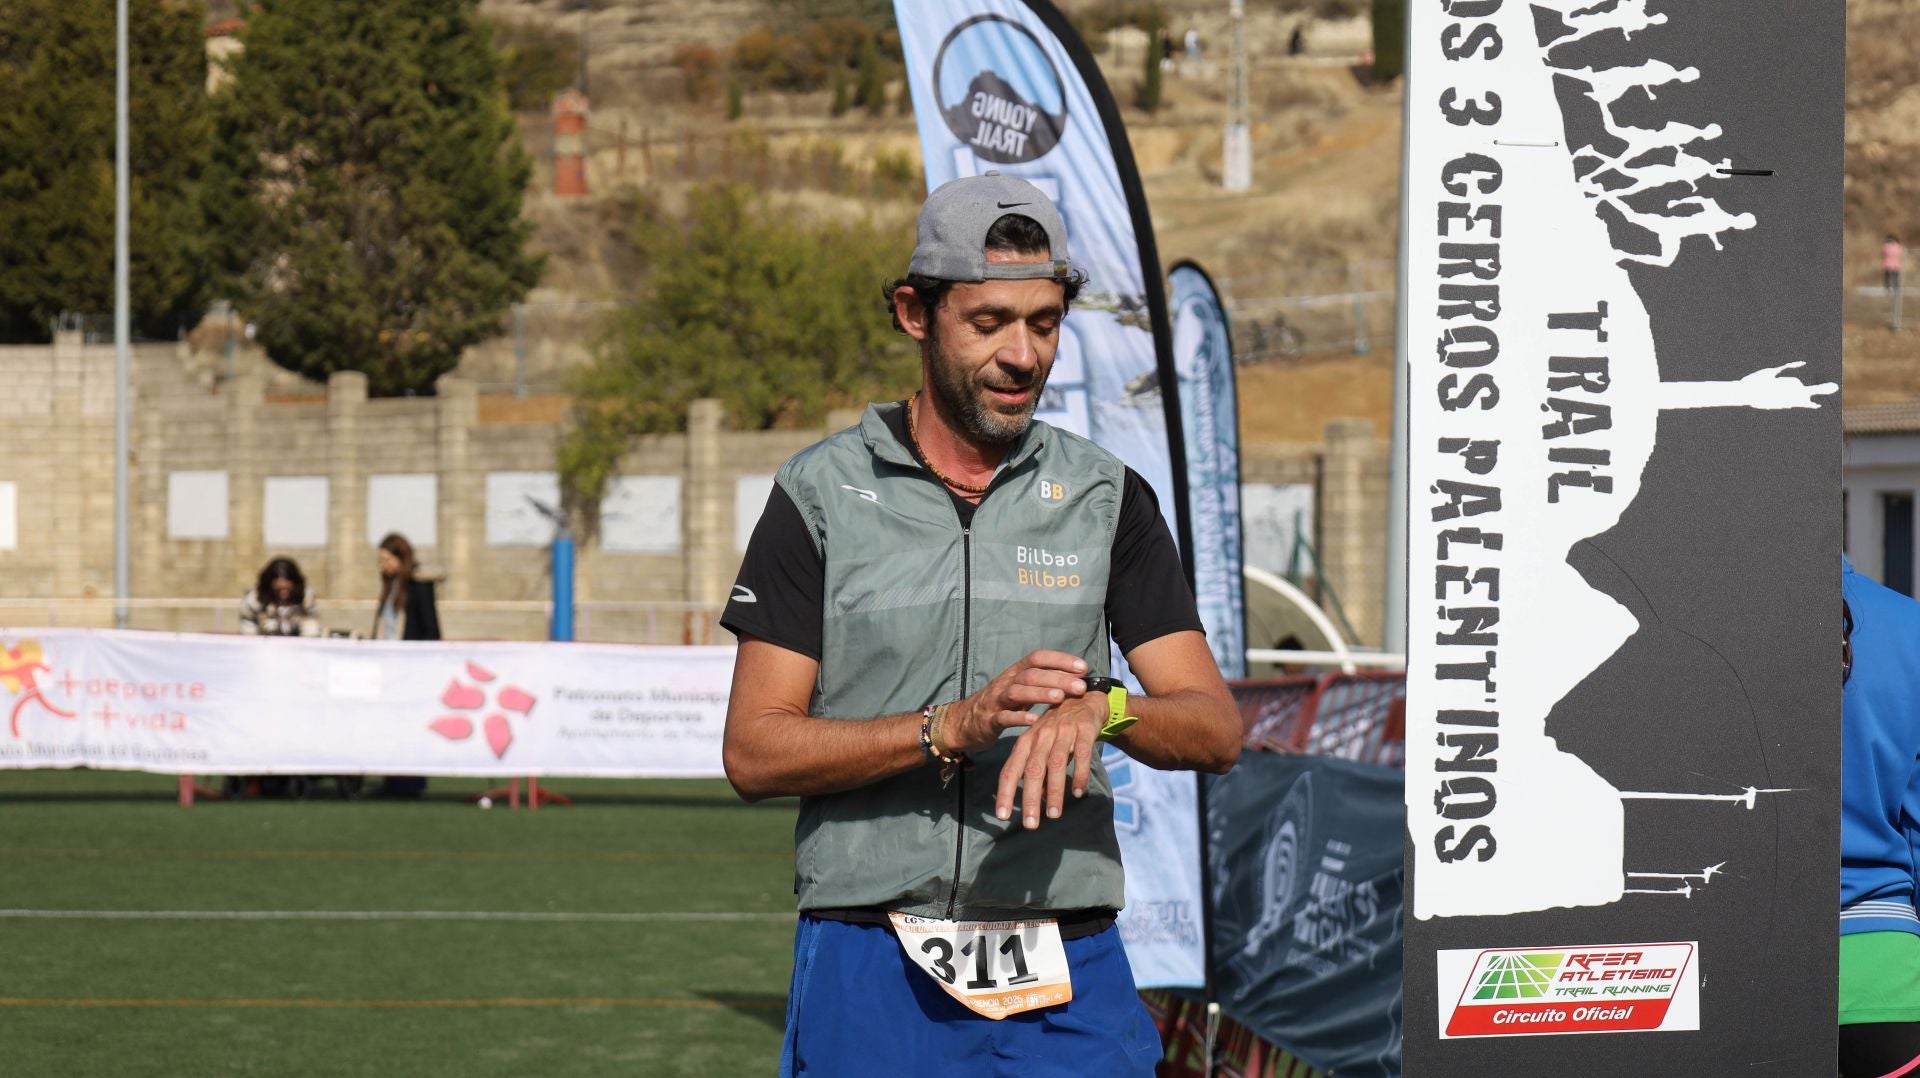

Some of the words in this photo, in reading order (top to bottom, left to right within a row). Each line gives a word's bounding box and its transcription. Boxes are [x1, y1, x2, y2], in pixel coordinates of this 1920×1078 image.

[1439, 86, 1502, 126] 3
[1437, 152, 1503, 411] CERROS
[1541, 300, 1613, 503] TRAIL
[1017, 545, 1078, 567] Bilbao
[1018, 567, 1080, 588] Bilbao
[1430, 437, 1503, 863] PALENTINOS
[921, 934, 1039, 989] 311
[1565, 952, 1643, 967] RFEA
[1559, 967, 1677, 982] ATLETISMO
[1555, 986, 1599, 998] TRAIL
[1602, 984, 1672, 996] RUNNING
[1493, 1009, 1567, 1025] Circuito
[1572, 1006, 1634, 1022] Oficial
